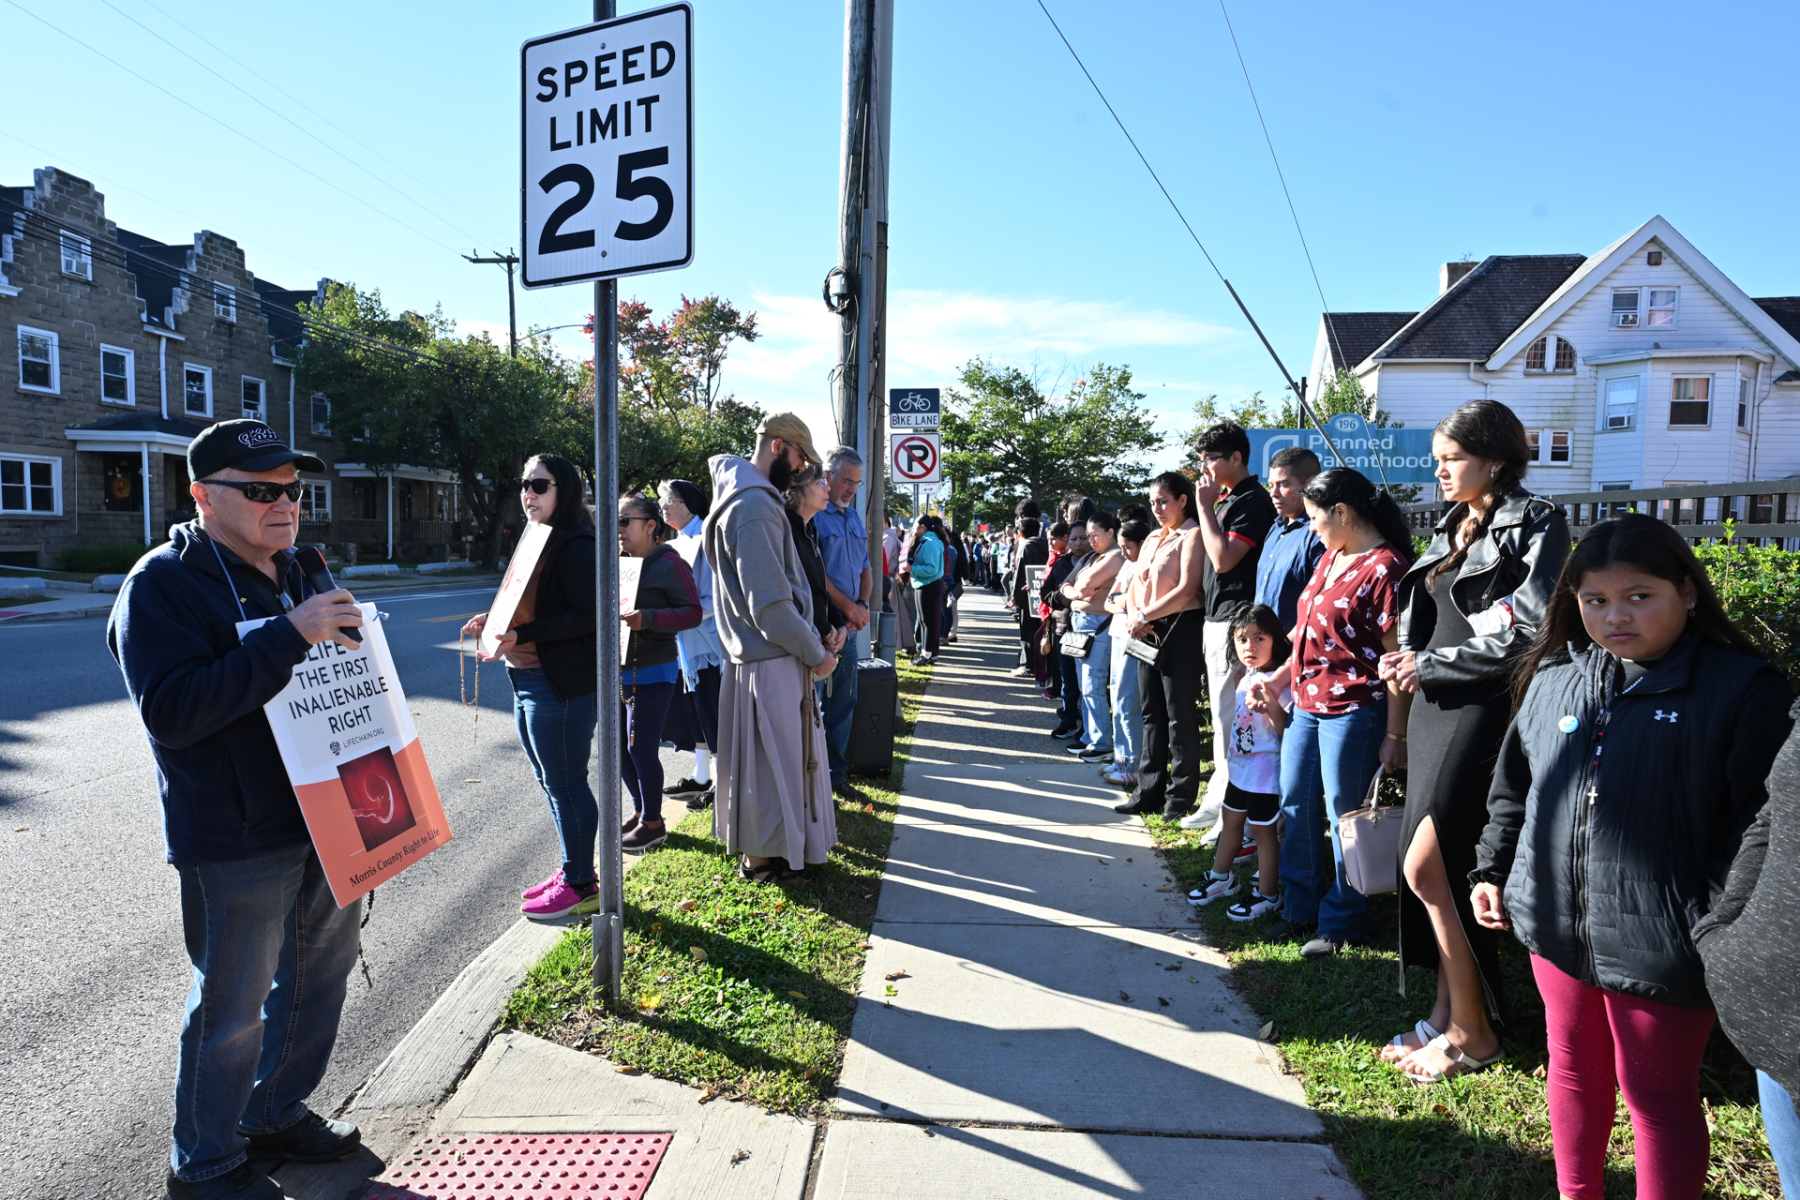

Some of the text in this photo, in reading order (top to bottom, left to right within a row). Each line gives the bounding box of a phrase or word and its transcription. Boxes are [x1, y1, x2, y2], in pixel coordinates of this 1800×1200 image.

[535, 40, 676, 103] SPEED
[550, 94, 660, 152] LIMIT
[538, 145, 674, 255] 25
[892, 415, 938, 425] BIKE LANE
[1338, 419, 1356, 429] 196
[306, 640, 347, 662] LIFE
[295, 657, 369, 690] THE FIRST
[288, 676, 389, 720] INALIENABLE
[328, 705, 372, 734] RIGHT
[342, 727, 385, 749] LIFECHAIN.ORG
[349, 828, 440, 888] Morris County Right to Life
